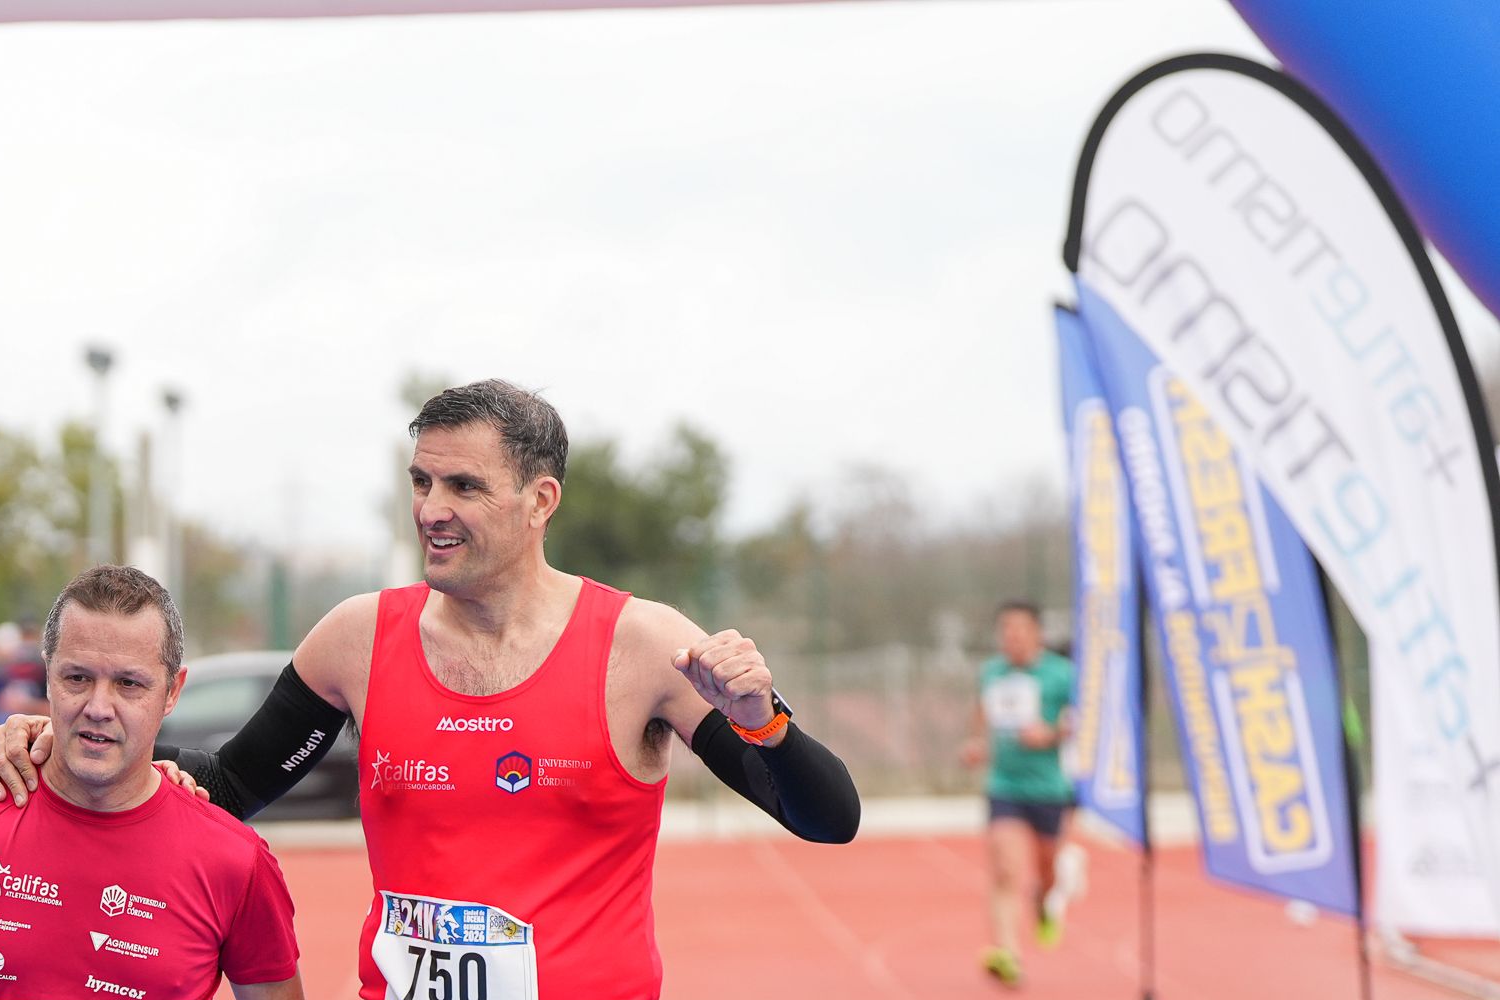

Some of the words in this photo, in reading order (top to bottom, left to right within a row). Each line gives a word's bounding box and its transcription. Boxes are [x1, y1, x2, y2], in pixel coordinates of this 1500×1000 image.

[281, 729, 326, 772] KIPRUN
[384, 759, 450, 783] califas
[538, 758, 592, 770] UNIVERSIDAD
[3, 874, 59, 898] califas
[129, 895, 167, 909] UNIVERSIDAD
[126, 907, 153, 920] CÓRDOBA
[400, 899, 436, 941] 21K
[106, 937, 159, 957] AGRIMENSUR
[463, 930, 485, 942] 2026
[85, 974, 146, 1000] hymcor
